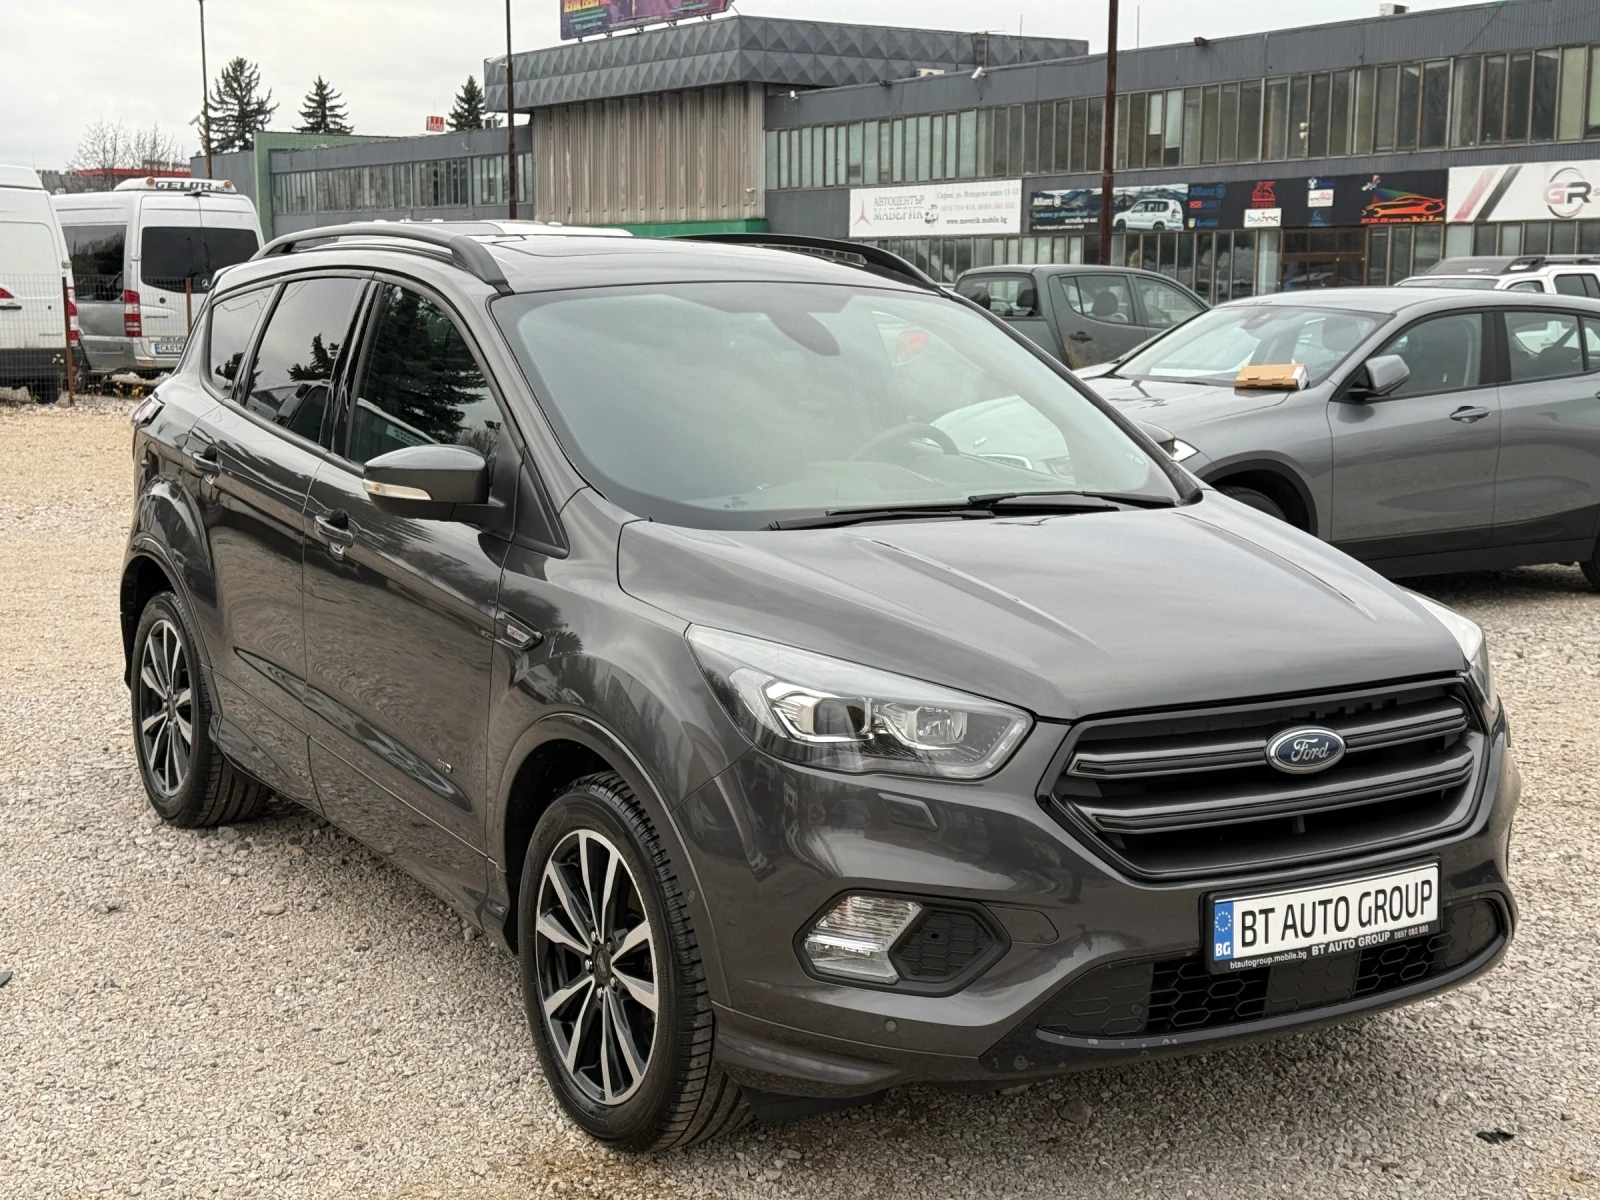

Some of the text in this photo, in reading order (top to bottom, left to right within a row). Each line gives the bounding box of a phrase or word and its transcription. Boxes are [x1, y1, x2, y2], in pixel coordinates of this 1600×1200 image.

[873, 195, 925, 207] АВТОЦЕНТЪР
[1033, 197, 1054, 206] Allianz
[1543, 181, 1592, 205] GR
[873, 207, 924, 221] МАВЕРИК
[1290, 737, 1330, 762] Ford
[1241, 879, 1433, 949] BT AUTO GROUP
[1215, 941, 1231, 957] BG
[1229, 949, 1308, 970] btautogroup.mobile.bg
[1311, 945, 1325, 957] BT
[1327, 939, 1356, 953] AUTO
[1358, 931, 1391, 948] GROUP
